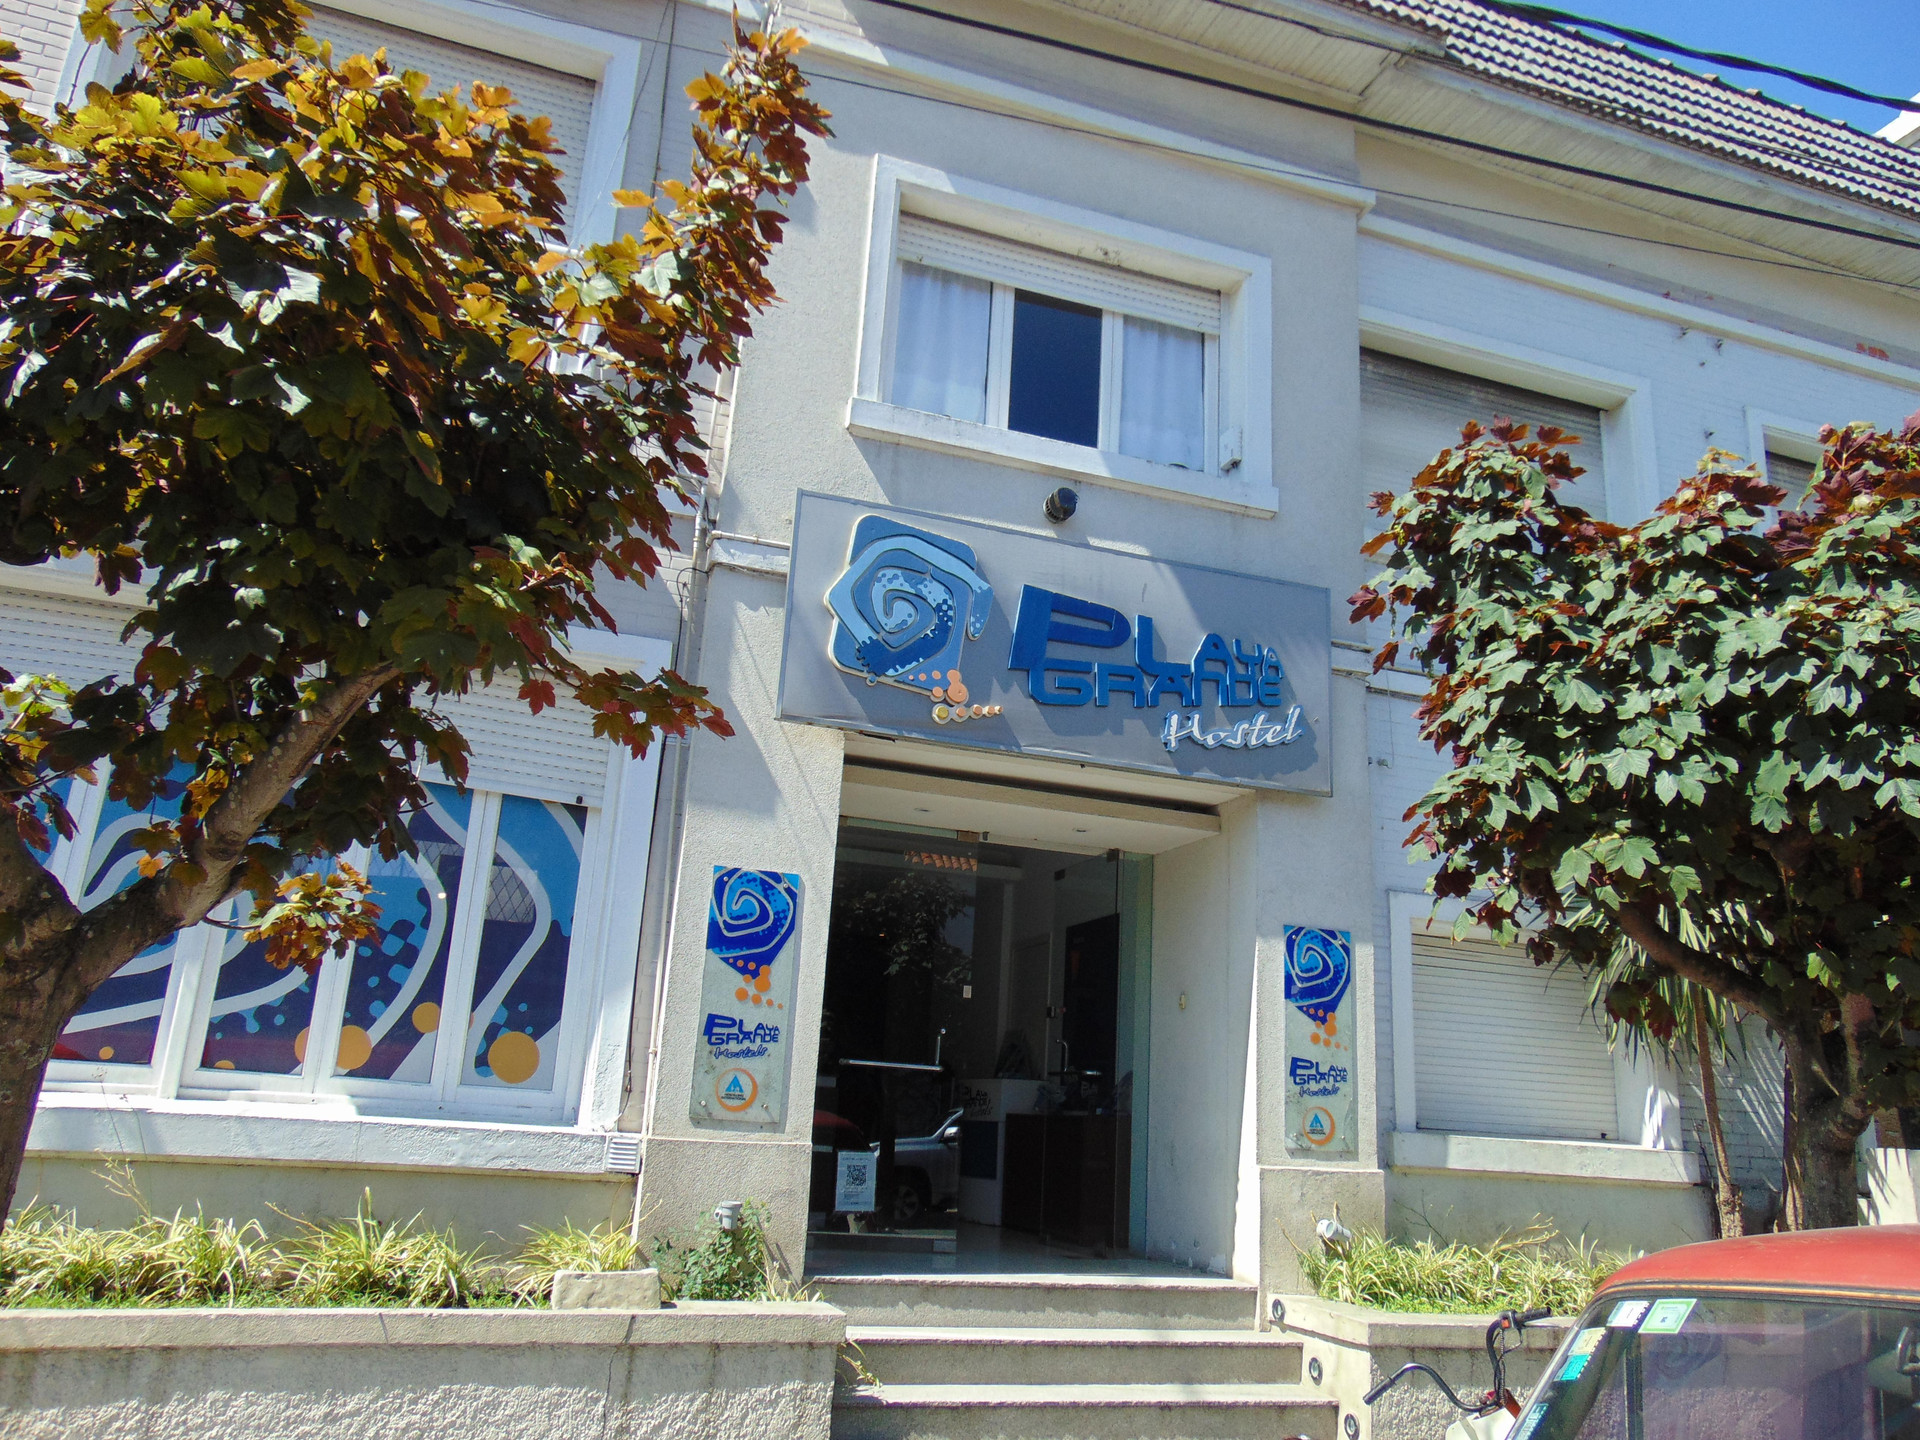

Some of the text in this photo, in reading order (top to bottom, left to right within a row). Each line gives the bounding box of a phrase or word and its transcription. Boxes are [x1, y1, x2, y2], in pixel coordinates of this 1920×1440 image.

[1008, 584, 1285, 679] PLAYA
[1028, 657, 1283, 708] GRANDE
[1161, 704, 1305, 752] Hostel
[703, 1013, 780, 1036] PLAYA
[707, 1032, 779, 1046] GRANDE
[1289, 1056, 1348, 1077] PLAYA
[1293, 1073, 1348, 1086] GRANDE
